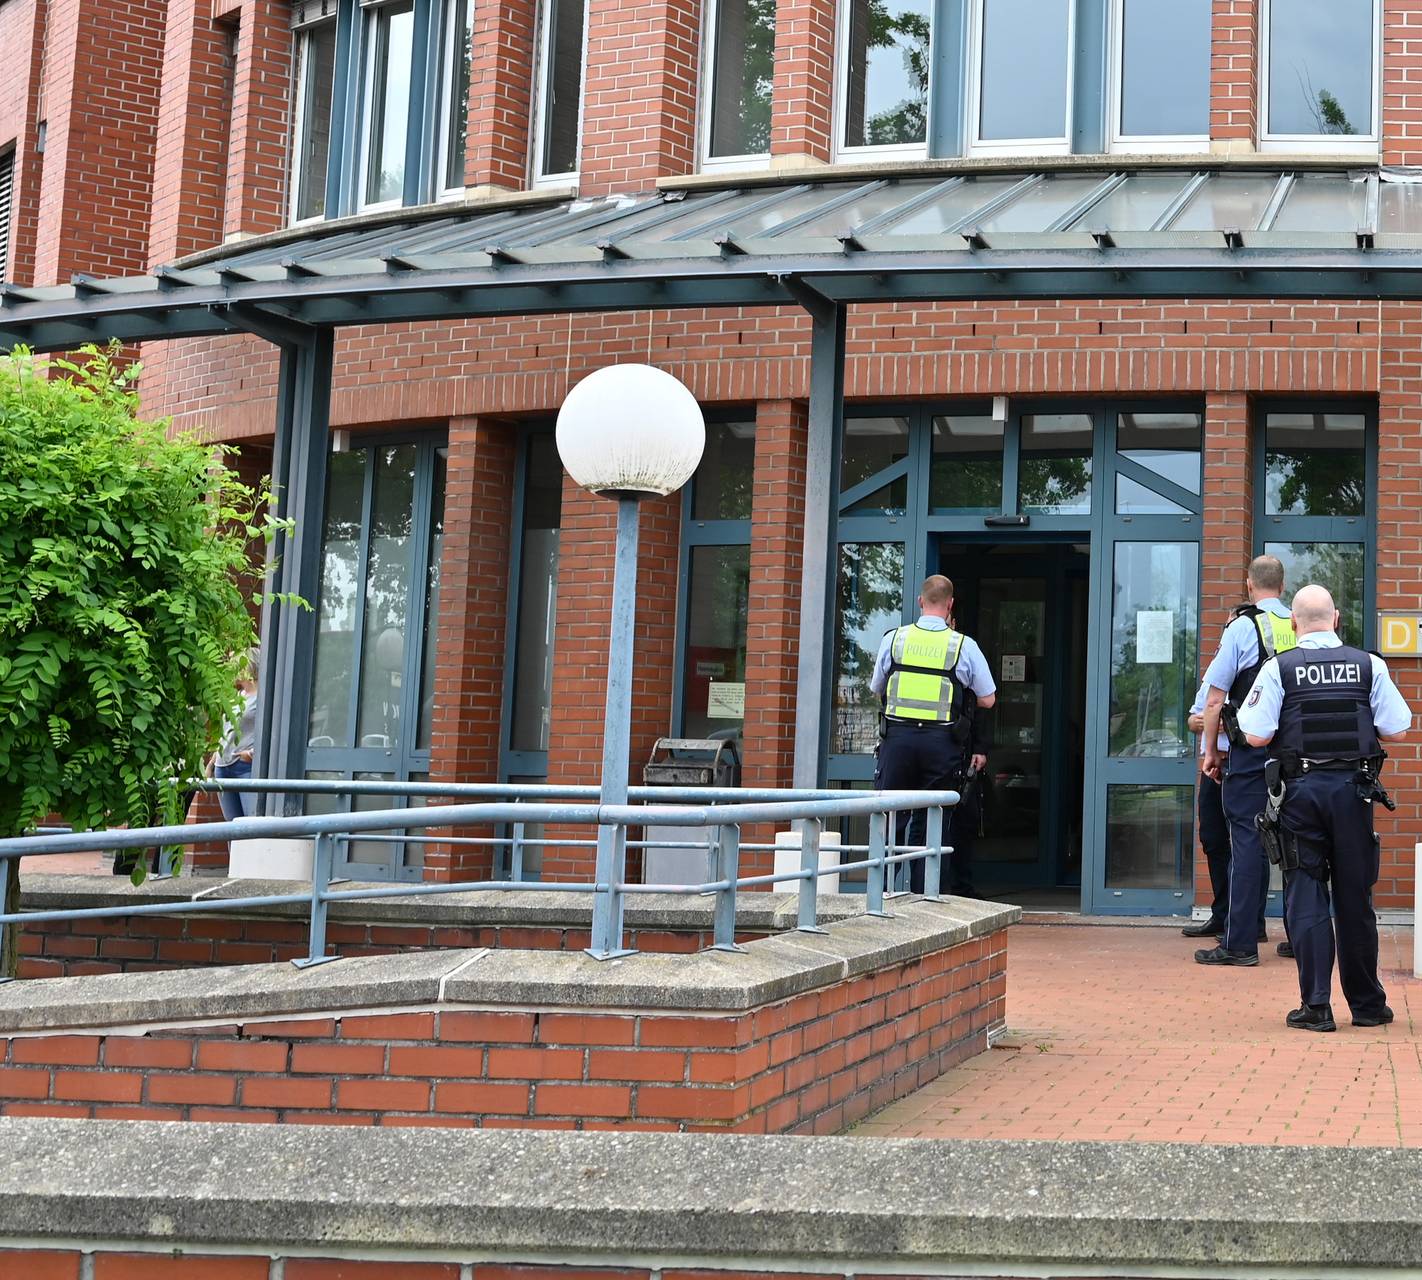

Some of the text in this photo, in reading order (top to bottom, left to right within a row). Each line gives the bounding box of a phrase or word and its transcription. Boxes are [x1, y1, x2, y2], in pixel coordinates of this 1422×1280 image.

[1276, 632, 1297, 646] POLI
[1387, 620, 1411, 650] D
[906, 643, 944, 660] POLIZEI
[1295, 663, 1361, 686] POLIZEI
